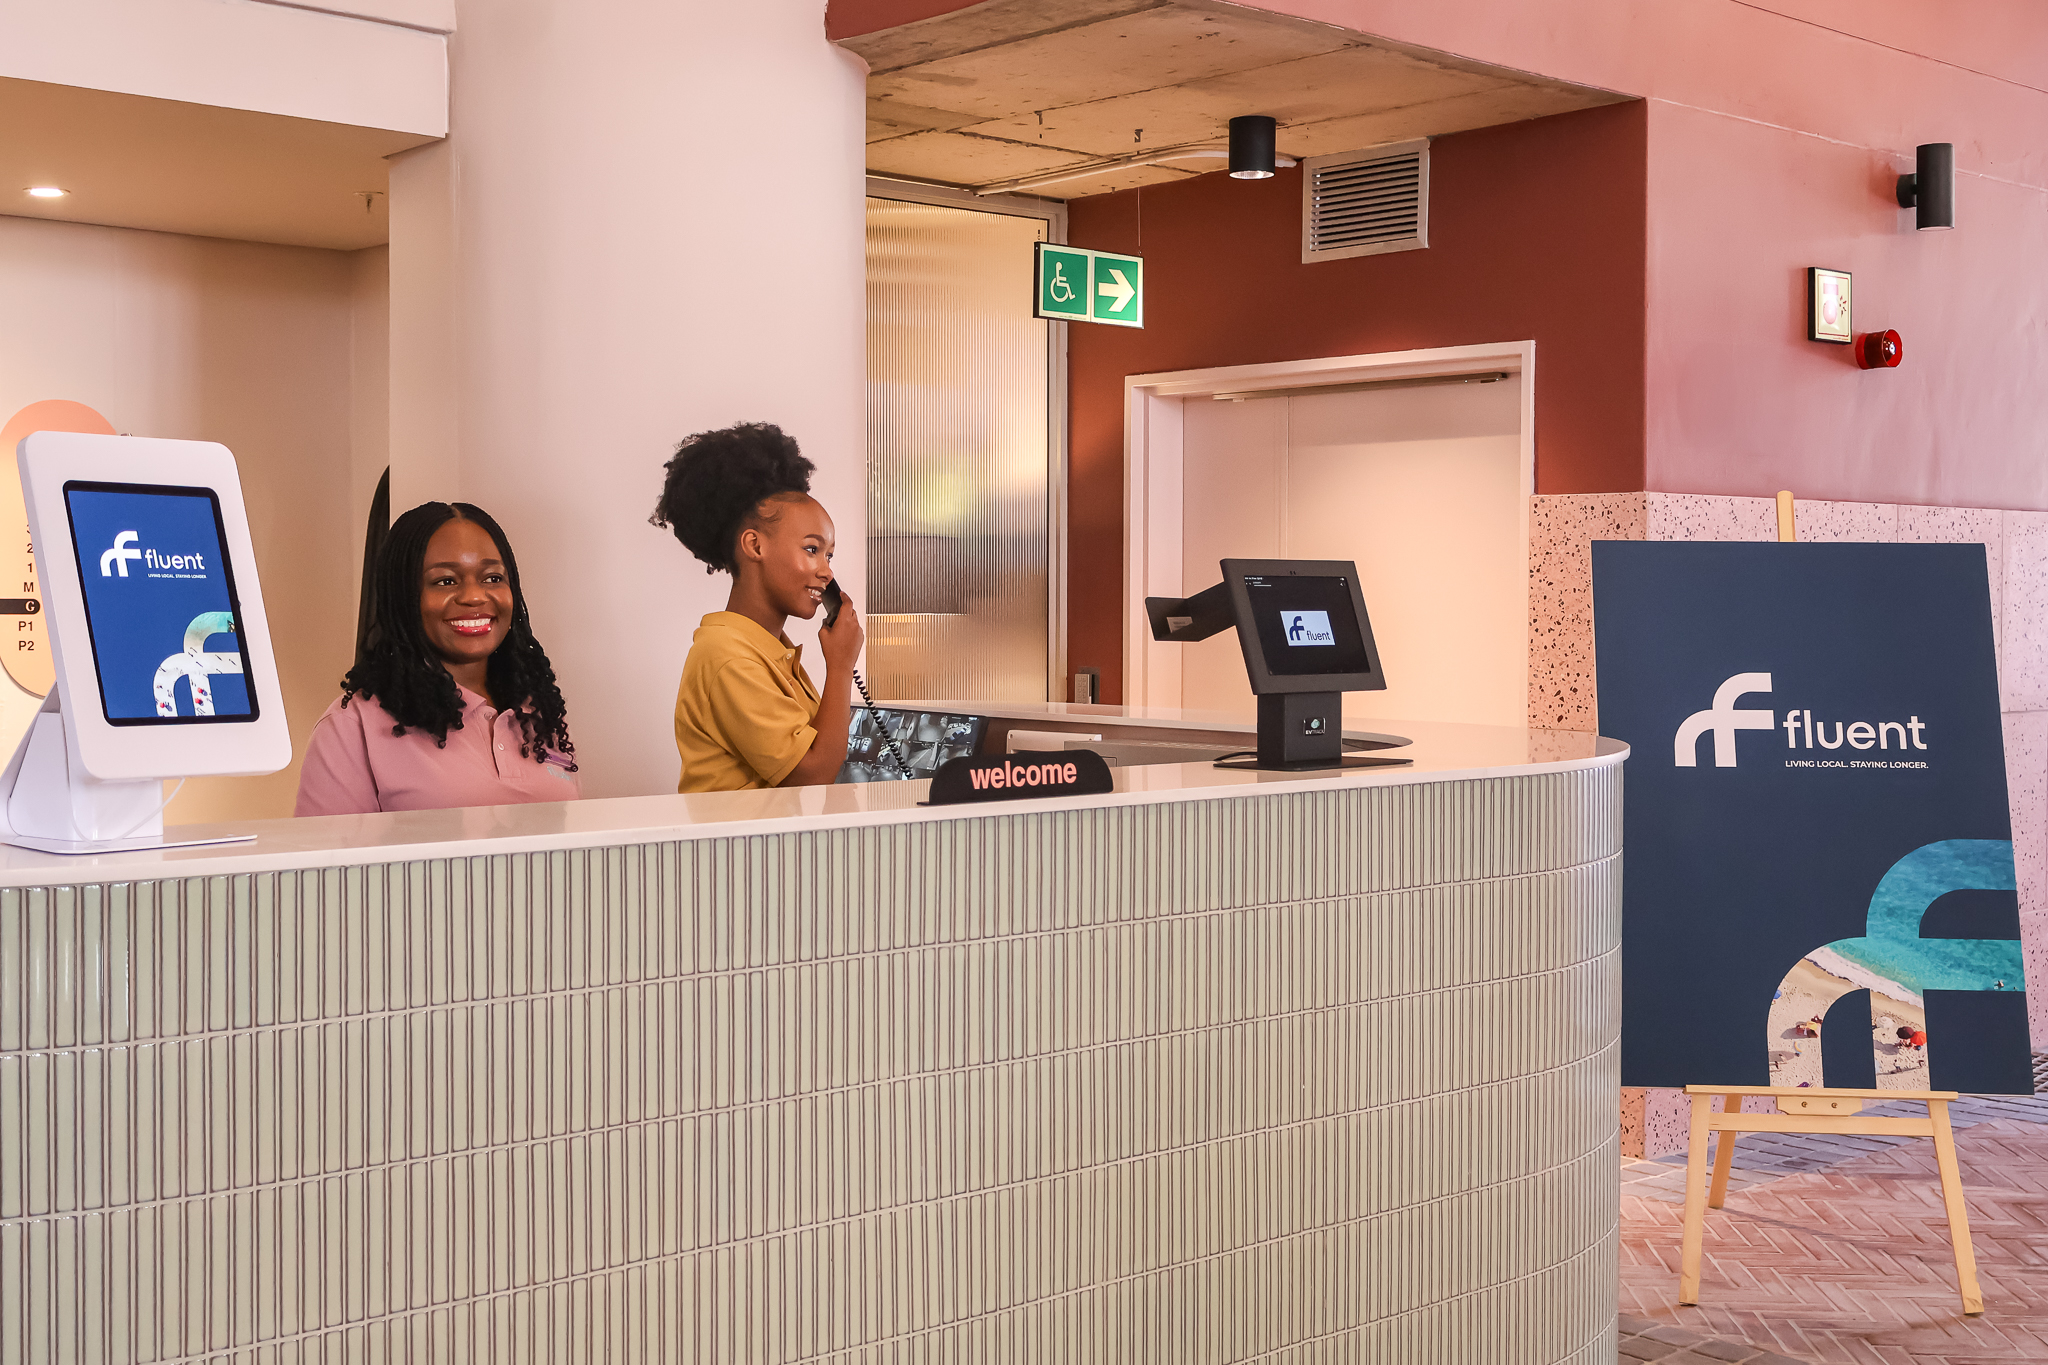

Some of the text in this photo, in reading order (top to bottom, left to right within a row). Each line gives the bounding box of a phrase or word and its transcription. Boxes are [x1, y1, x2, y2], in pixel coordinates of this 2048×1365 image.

[26, 543, 34, 553] 2
[144, 548, 206, 570] fluent
[27, 562, 33, 573] 1
[23, 581, 34, 593] M
[25, 600, 36, 612] G
[18, 620, 33, 632] P1
[1306, 630, 1331, 641] fluent
[18, 640, 35, 651] P2
[1783, 709, 1928, 750] fluent
[1785, 760, 1929, 769] LIVING LOCAL. STAYING LONGER.
[969, 760, 1078, 790] welcome
